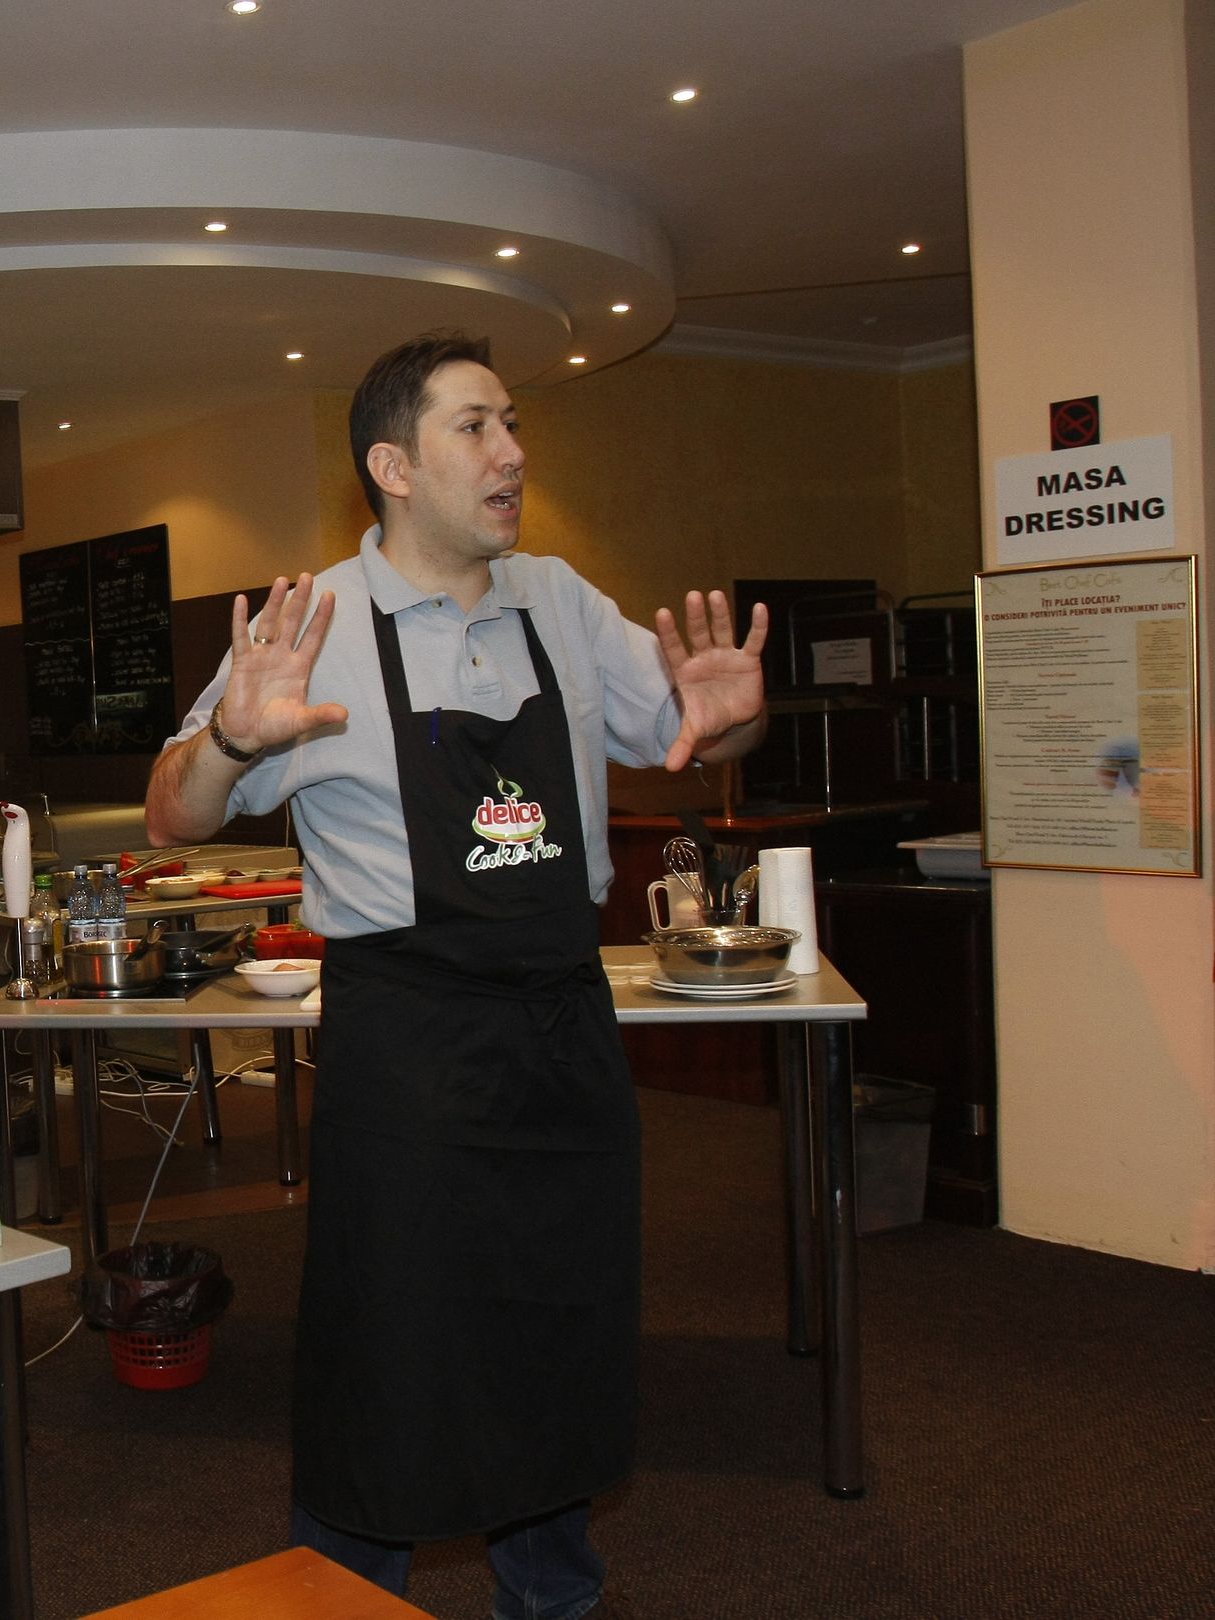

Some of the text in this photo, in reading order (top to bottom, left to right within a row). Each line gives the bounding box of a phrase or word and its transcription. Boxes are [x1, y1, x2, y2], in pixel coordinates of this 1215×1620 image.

[1037, 465, 1126, 497] MASA
[1004, 497, 1165, 536] DRESSING
[991, 612, 1028, 621] CONSIDERI
[1070, 607, 1098, 616] PENTRU
[1115, 604, 1159, 613] EVENIMENT
[1055, 597, 1078, 607] PLACE
[476, 797, 542, 826] delice
